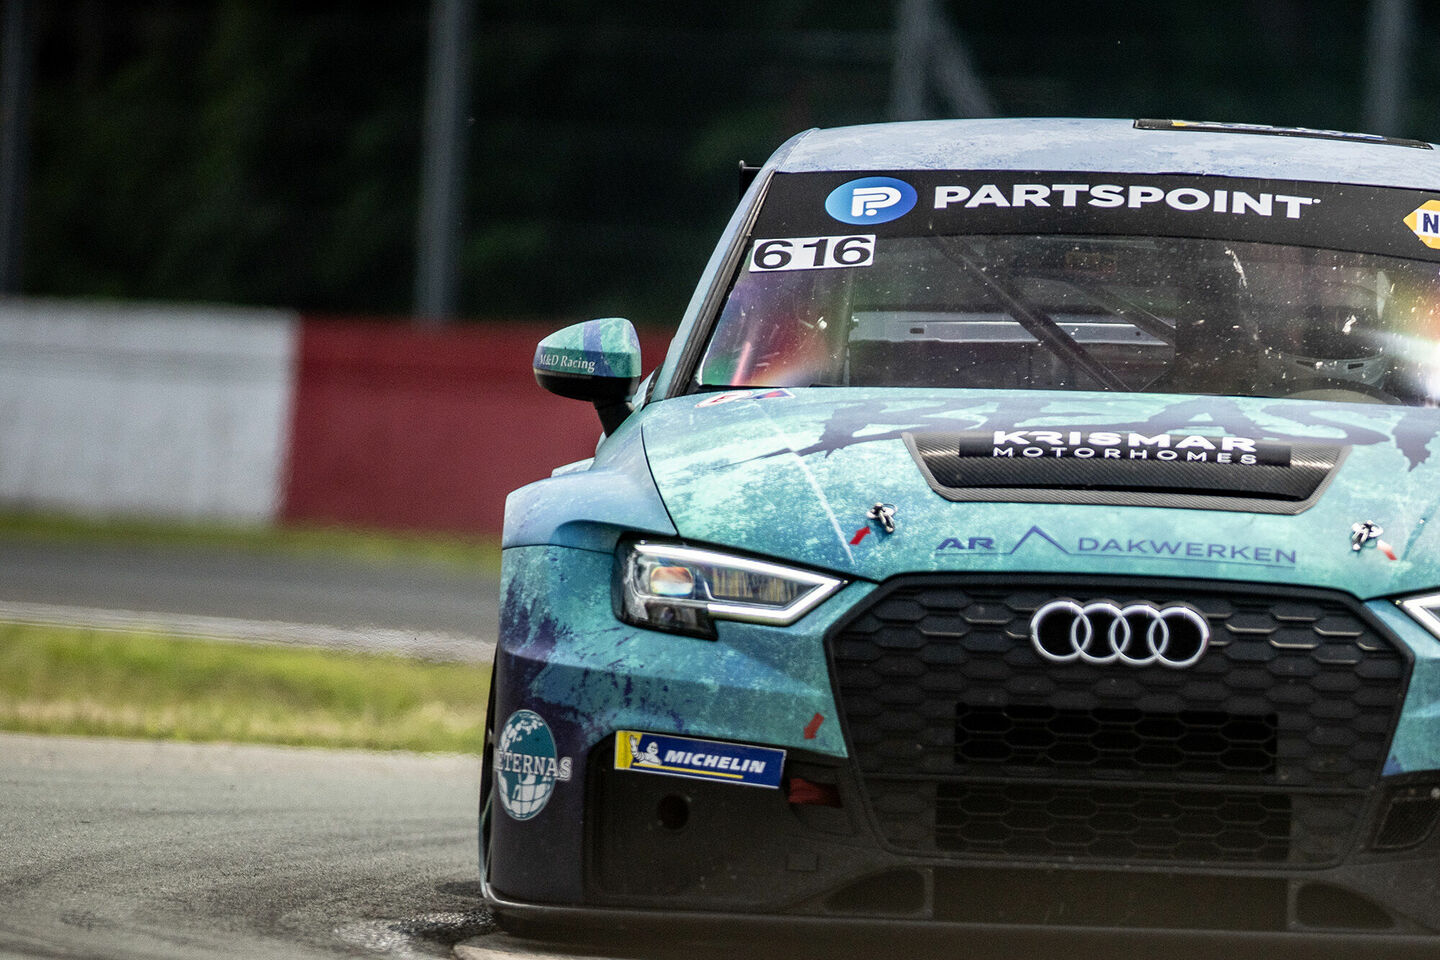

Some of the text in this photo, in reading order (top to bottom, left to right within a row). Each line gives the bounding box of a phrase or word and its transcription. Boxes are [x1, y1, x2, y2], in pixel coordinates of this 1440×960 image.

[934, 184, 1312, 219] PARTSPOINT
[753, 236, 873, 269] 616
[540, 354, 596, 374] M&D Racing
[993, 430, 1257, 452] KRISMAR
[993, 446, 1257, 465] MOTORHOMES
[935, 537, 1296, 564] AR DAKWERKEN
[494, 749, 572, 781] ETERNAS
[664, 750, 767, 774] MICHELIN
